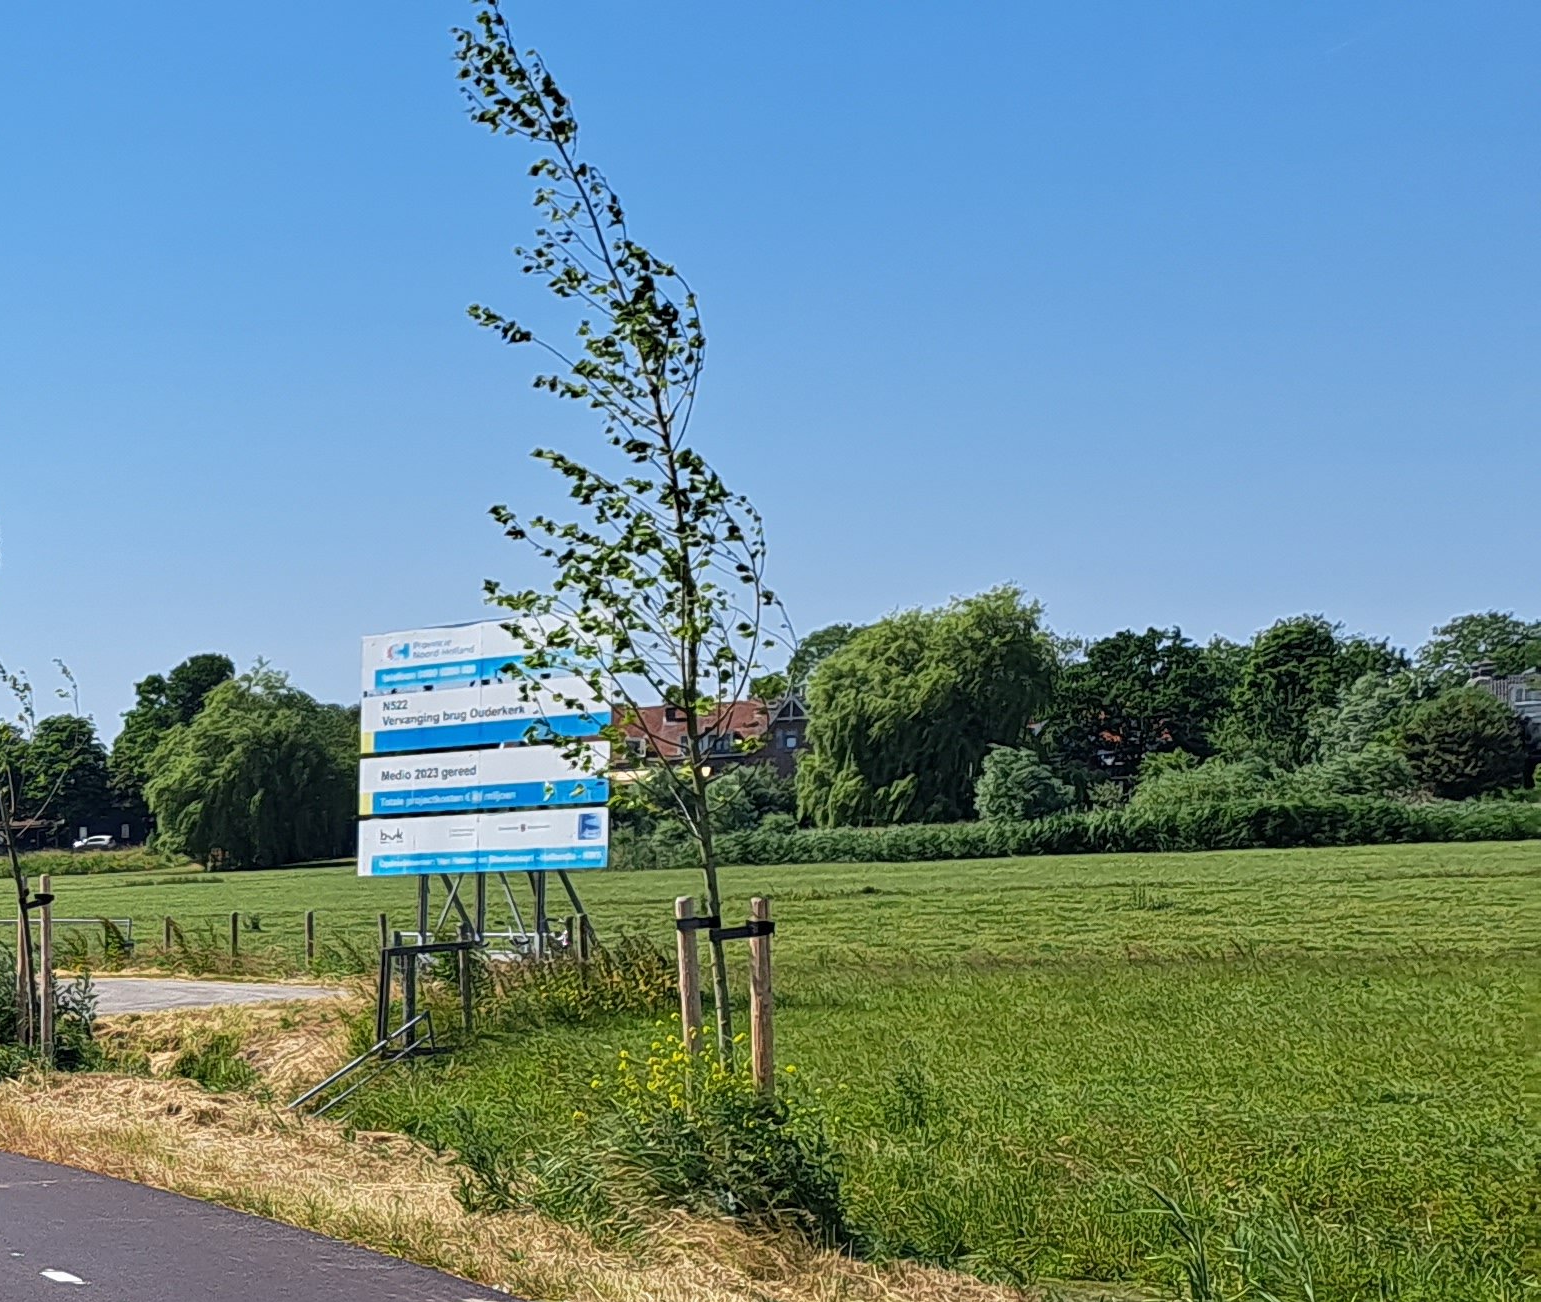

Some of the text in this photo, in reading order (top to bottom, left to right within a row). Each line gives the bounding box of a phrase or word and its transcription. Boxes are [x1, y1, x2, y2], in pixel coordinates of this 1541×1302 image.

[382, 699, 408, 711] N522
[382, 704, 525, 726] Vervanging brug Ouderkerk
[381, 765, 477, 781] Medio 2023 gereed
